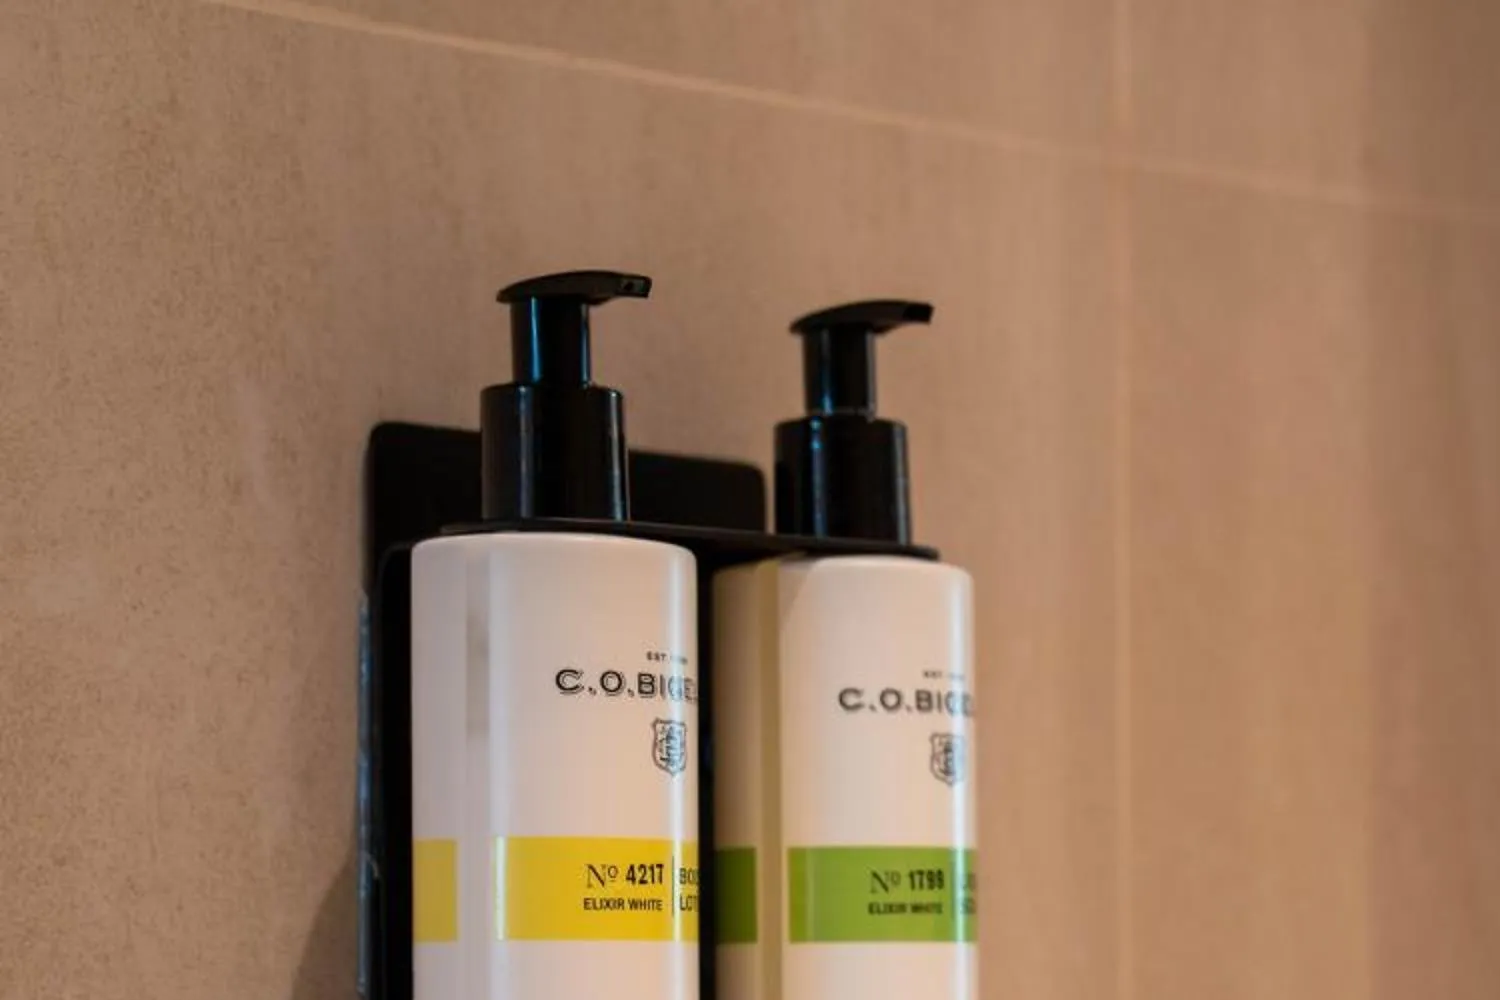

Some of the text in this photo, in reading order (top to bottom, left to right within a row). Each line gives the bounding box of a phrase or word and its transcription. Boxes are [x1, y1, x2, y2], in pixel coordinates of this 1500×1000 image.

[626, 863, 664, 885] 4217
[583, 898, 663, 911] ELIXIR WHITE
